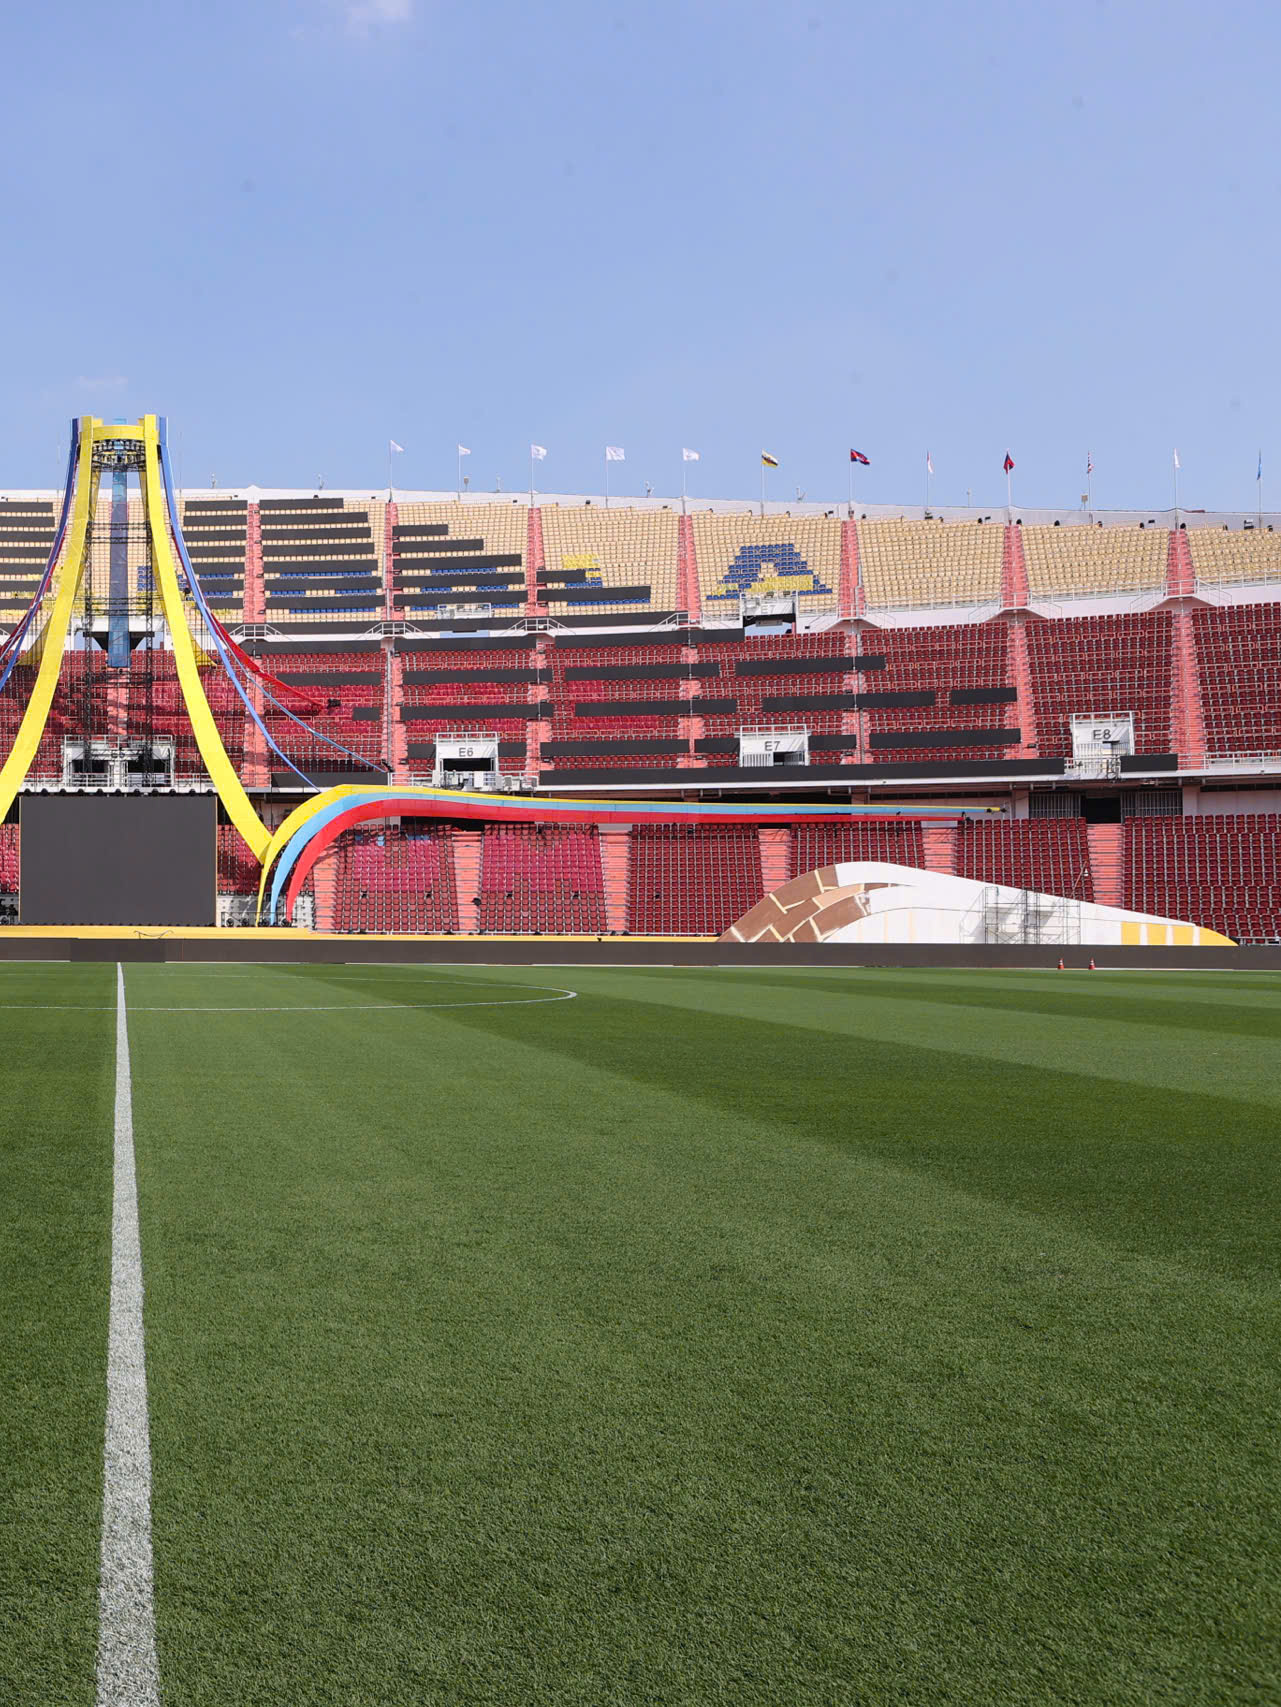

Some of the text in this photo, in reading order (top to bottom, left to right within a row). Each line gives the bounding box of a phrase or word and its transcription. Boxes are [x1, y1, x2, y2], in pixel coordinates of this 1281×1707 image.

[1093, 729, 1111, 740] E8
[764, 740, 781, 752] E7
[458, 747, 474, 757] E6
